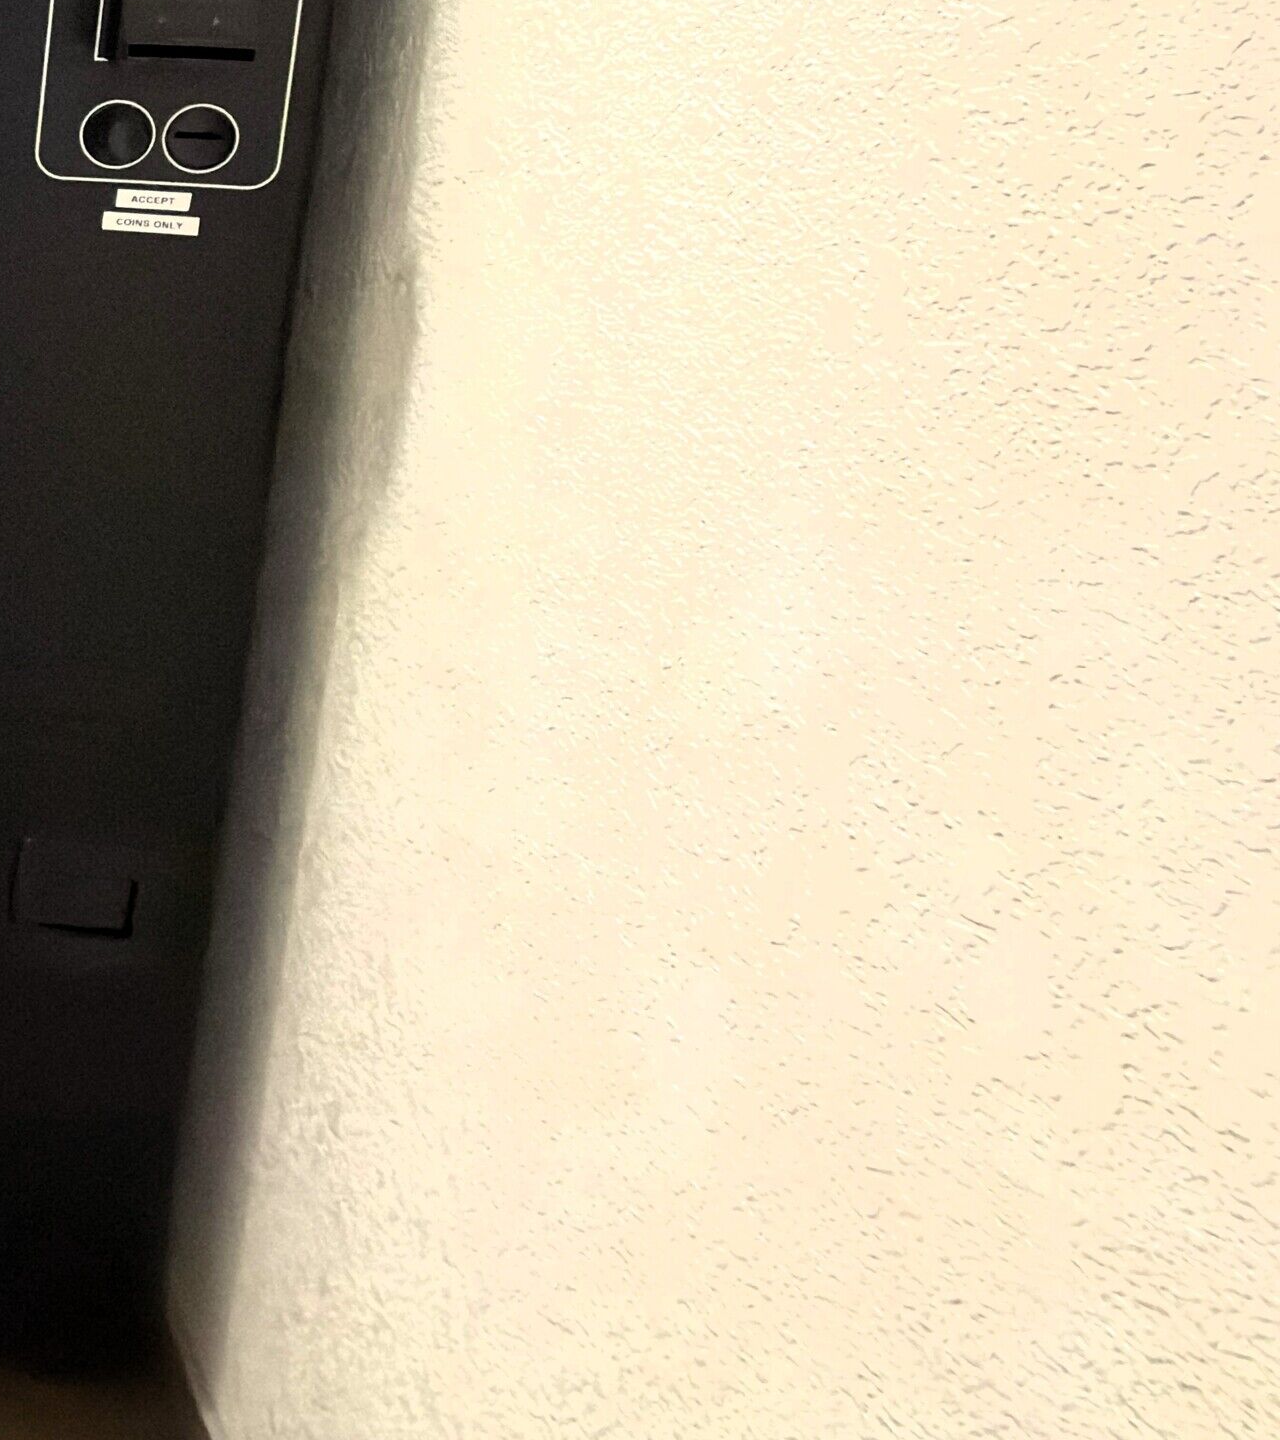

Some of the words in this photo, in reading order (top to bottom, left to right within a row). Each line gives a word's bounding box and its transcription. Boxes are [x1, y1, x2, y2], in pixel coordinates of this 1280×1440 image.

[131, 195, 176, 205] ACCEPT
[116, 218, 150, 227] COINS
[153, 220, 184, 230] ONLY
